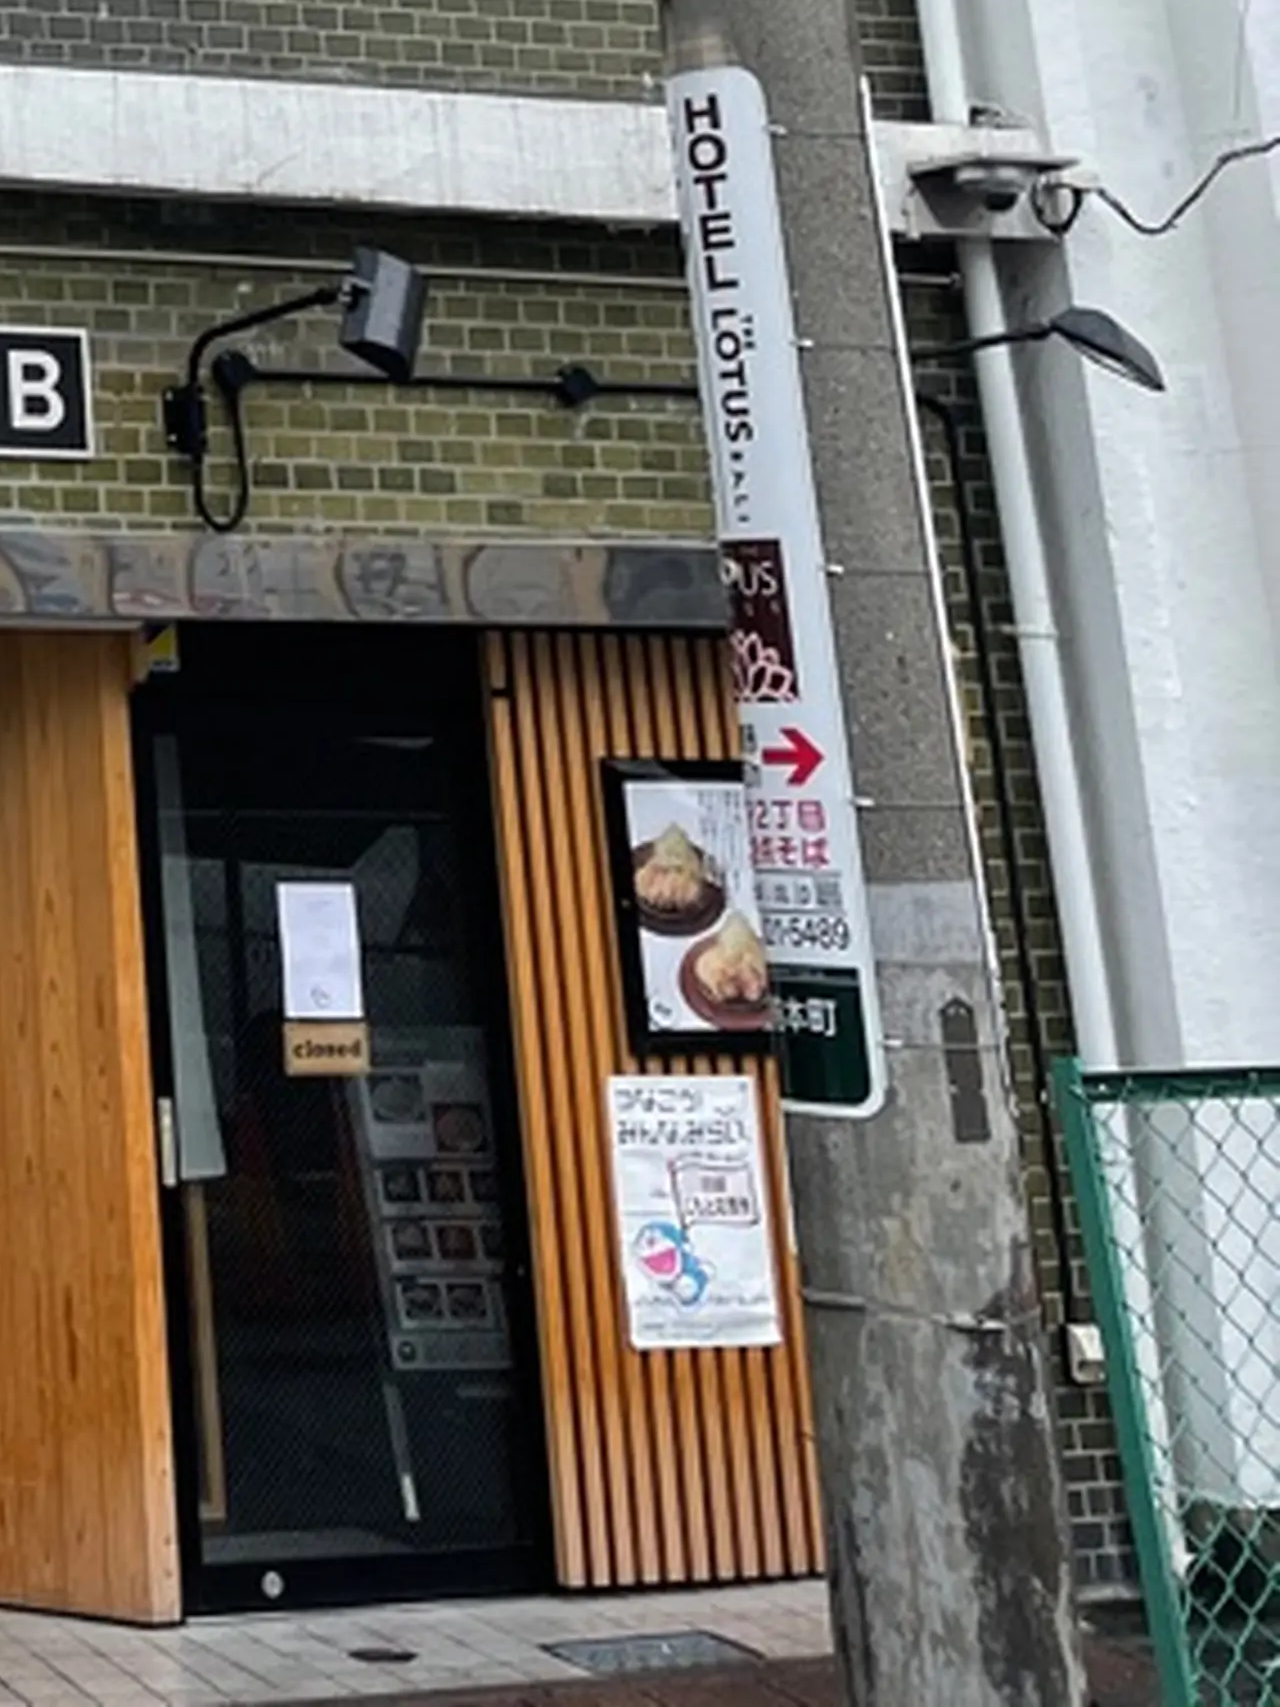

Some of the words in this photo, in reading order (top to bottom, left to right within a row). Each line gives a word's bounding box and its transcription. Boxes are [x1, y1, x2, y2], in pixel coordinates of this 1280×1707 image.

[684, 94, 739, 292] HOTEL
[711, 307, 754, 444] LOTUS
[292, 1039, 364, 1060] closed
